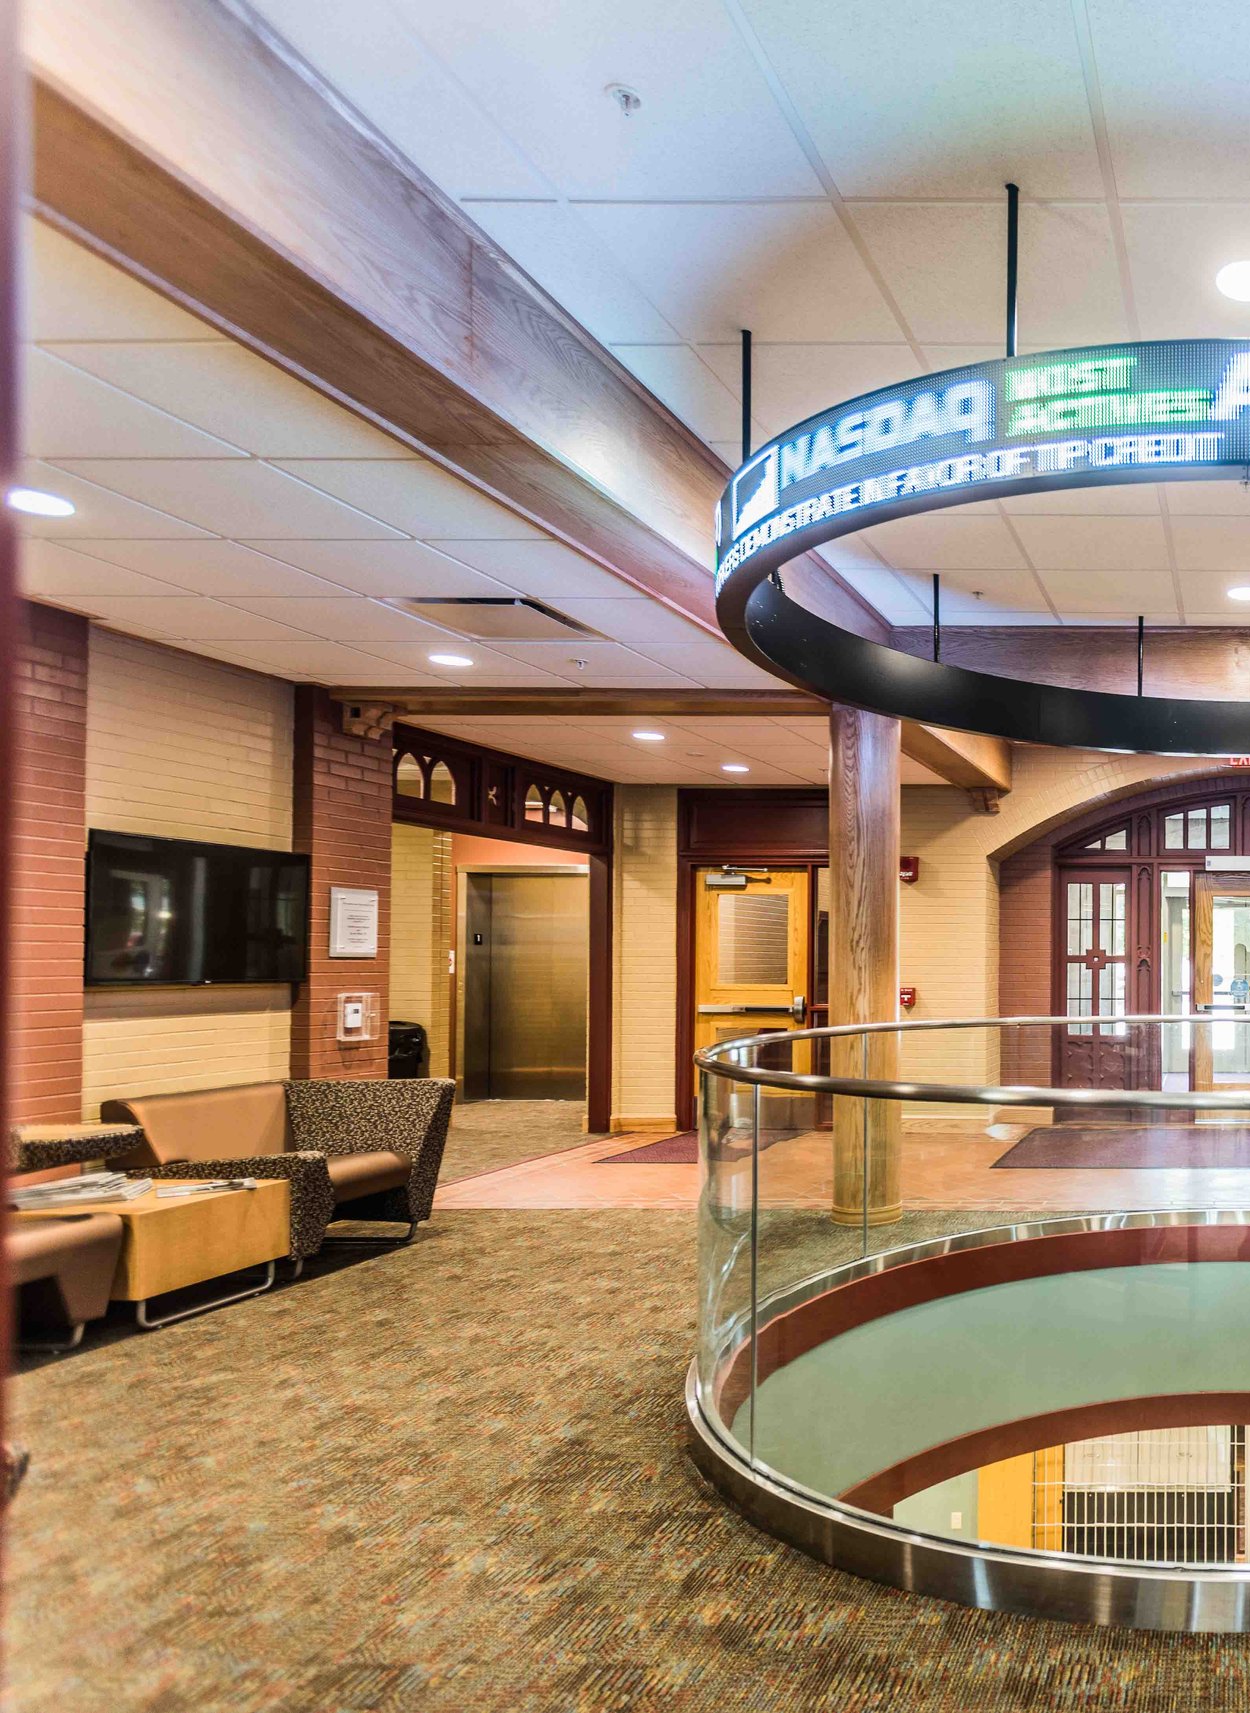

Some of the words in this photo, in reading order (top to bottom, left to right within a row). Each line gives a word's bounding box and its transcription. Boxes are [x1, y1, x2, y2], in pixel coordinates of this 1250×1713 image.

[1005, 356, 1137, 401] MOST
[780, 380, 996, 491] NASDAQ
[1006, 387, 1213, 437] ACTIVES
[887, 454, 984, 499] FAVOR
[986, 447, 1031, 480] OF
[1037, 439, 1091, 473] TIP
[1091, 431, 1224, 468] CREDIT
